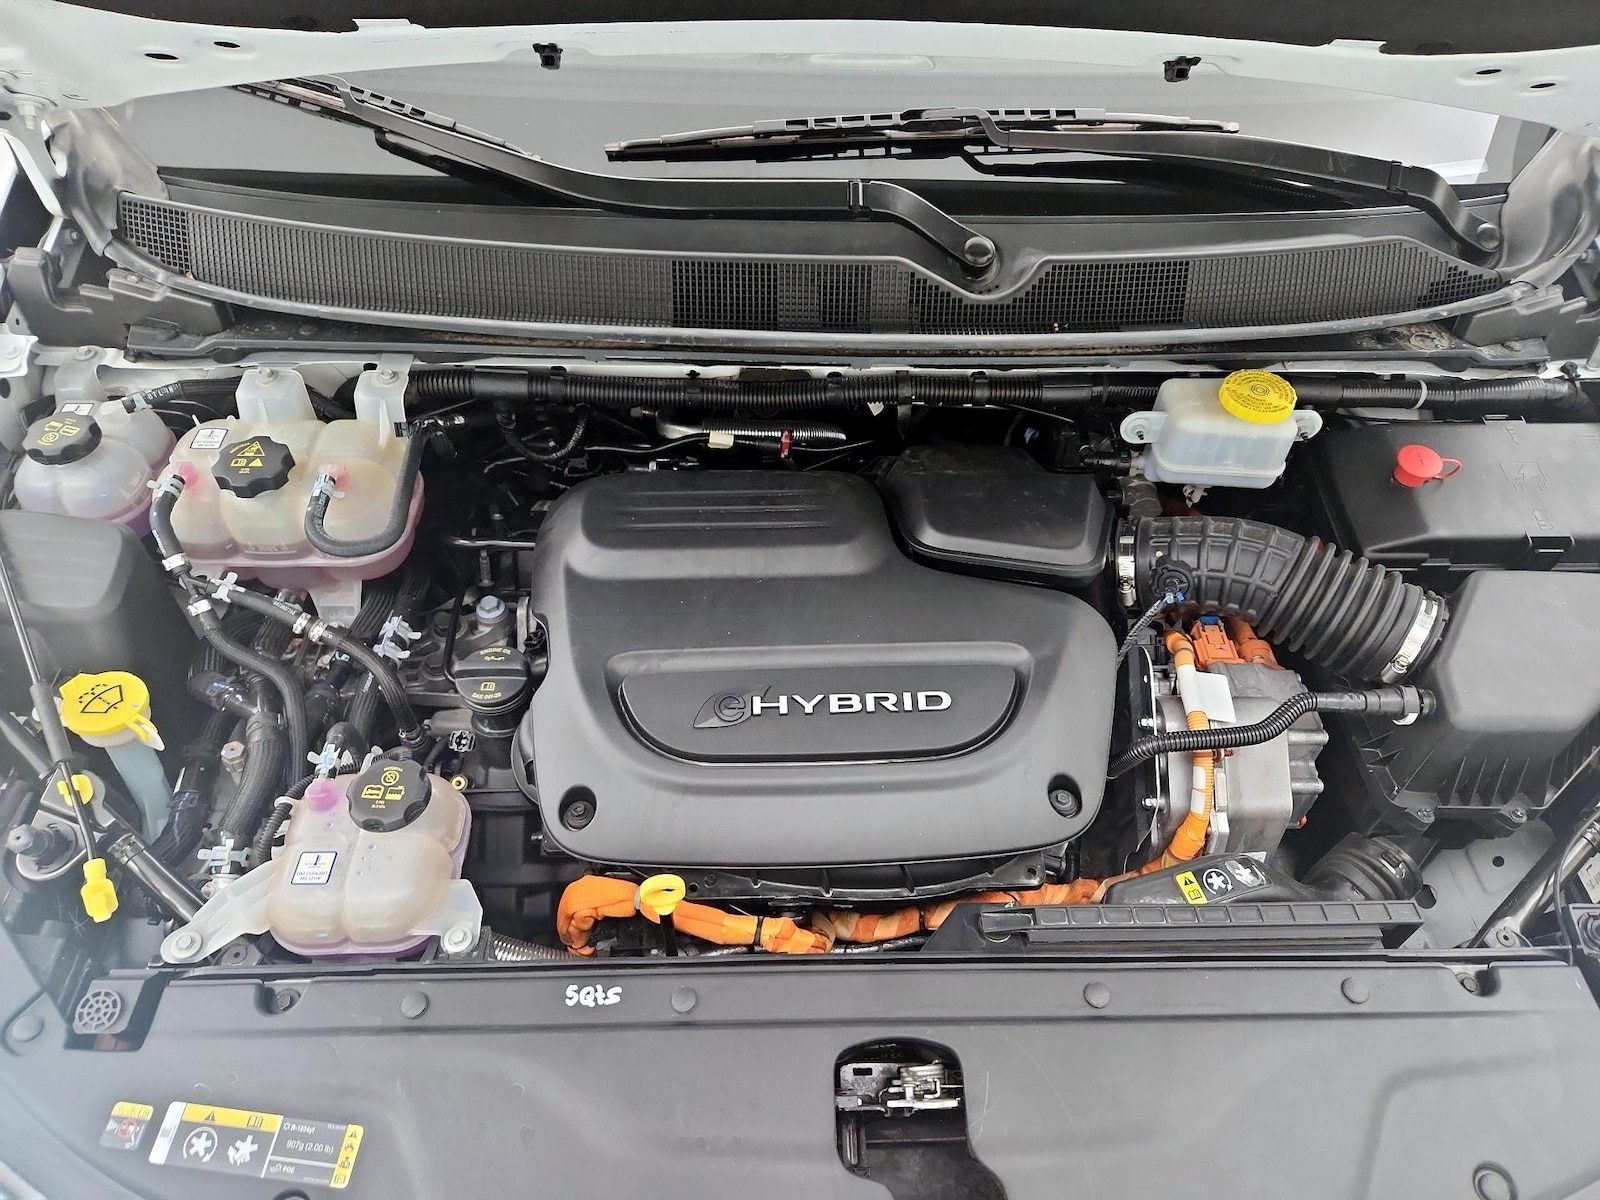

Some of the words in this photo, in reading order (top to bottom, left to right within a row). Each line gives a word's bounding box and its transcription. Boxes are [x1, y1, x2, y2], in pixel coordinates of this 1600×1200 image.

[479, 647, 502, 655] ENGINE
[503, 647, 512, 655] OIL
[471, 691, 483, 700] SAE
[484, 691, 502, 700] 0W-20
[286, 1138, 305, 1151] 907g
[305, 1141, 324, 1153] (2.00
[324, 1145, 335, 1156] lb)
